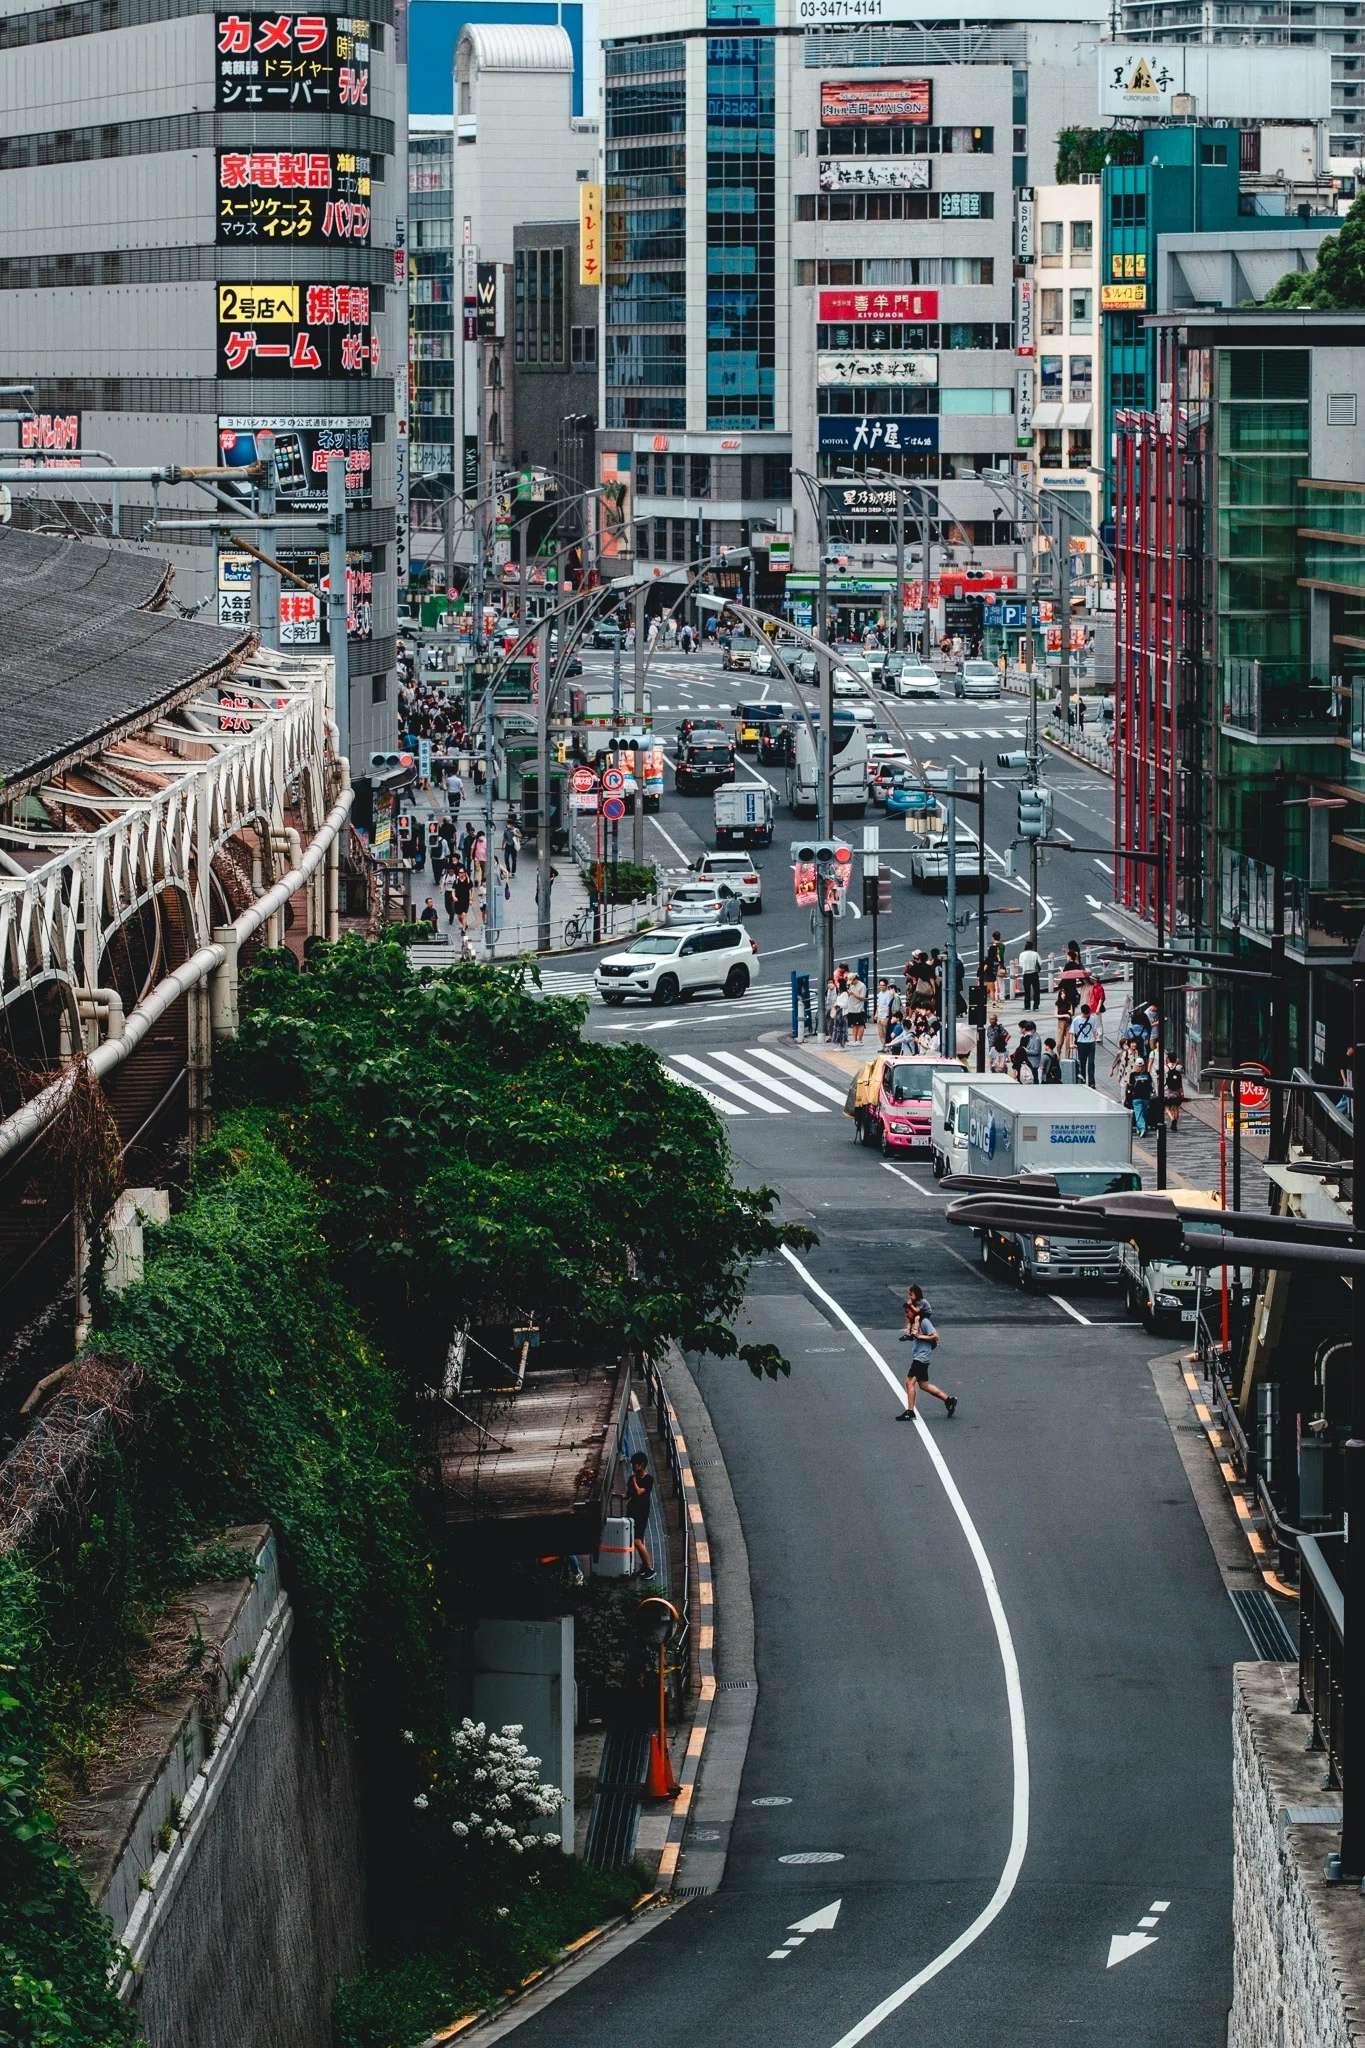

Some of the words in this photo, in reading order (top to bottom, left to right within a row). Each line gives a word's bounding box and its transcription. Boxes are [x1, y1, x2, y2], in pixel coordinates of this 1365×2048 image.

[800, 1, 882, 17] 03-3471-4141
[218, 16, 327, 53] カメラ
[221, 61, 258, 75] 美顔器
[265, 60, 333, 77] ドライヤー
[1110, 67, 1174, 92] 黒船亭
[222, 80, 330, 103] シェーバー
[338, 67, 368, 106] テレビ
[220, 153, 331, 188] 家電製品
[942, 194, 979, 216] 全席個室
[1022, 189, 1031, 200] K
[221, 198, 312, 216] スーツケース
[322, 199, 370, 238] パソコン
[221, 222, 258, 236] マウス
[263, 218, 312, 237] インク
[585, 216, 598, 275] ひよ子
[222, 289, 293, 320] 2号店へ
[855, 295, 909, 311] 喜羊門
[224, 331, 321, 370] ゲーム
[22, 414, 78, 450] ヨドバシカメラ
[227, 418, 344, 428] ヨドバシカメラの公式通販サイト
[853, 419, 901, 450] 大戸屋
[721, 441, 740, 449] au
[1006, 608, 1016, 623] P
[969, 1118, 990, 1153] CNG
[1050, 1135, 1096, 1144] SAGAWA
